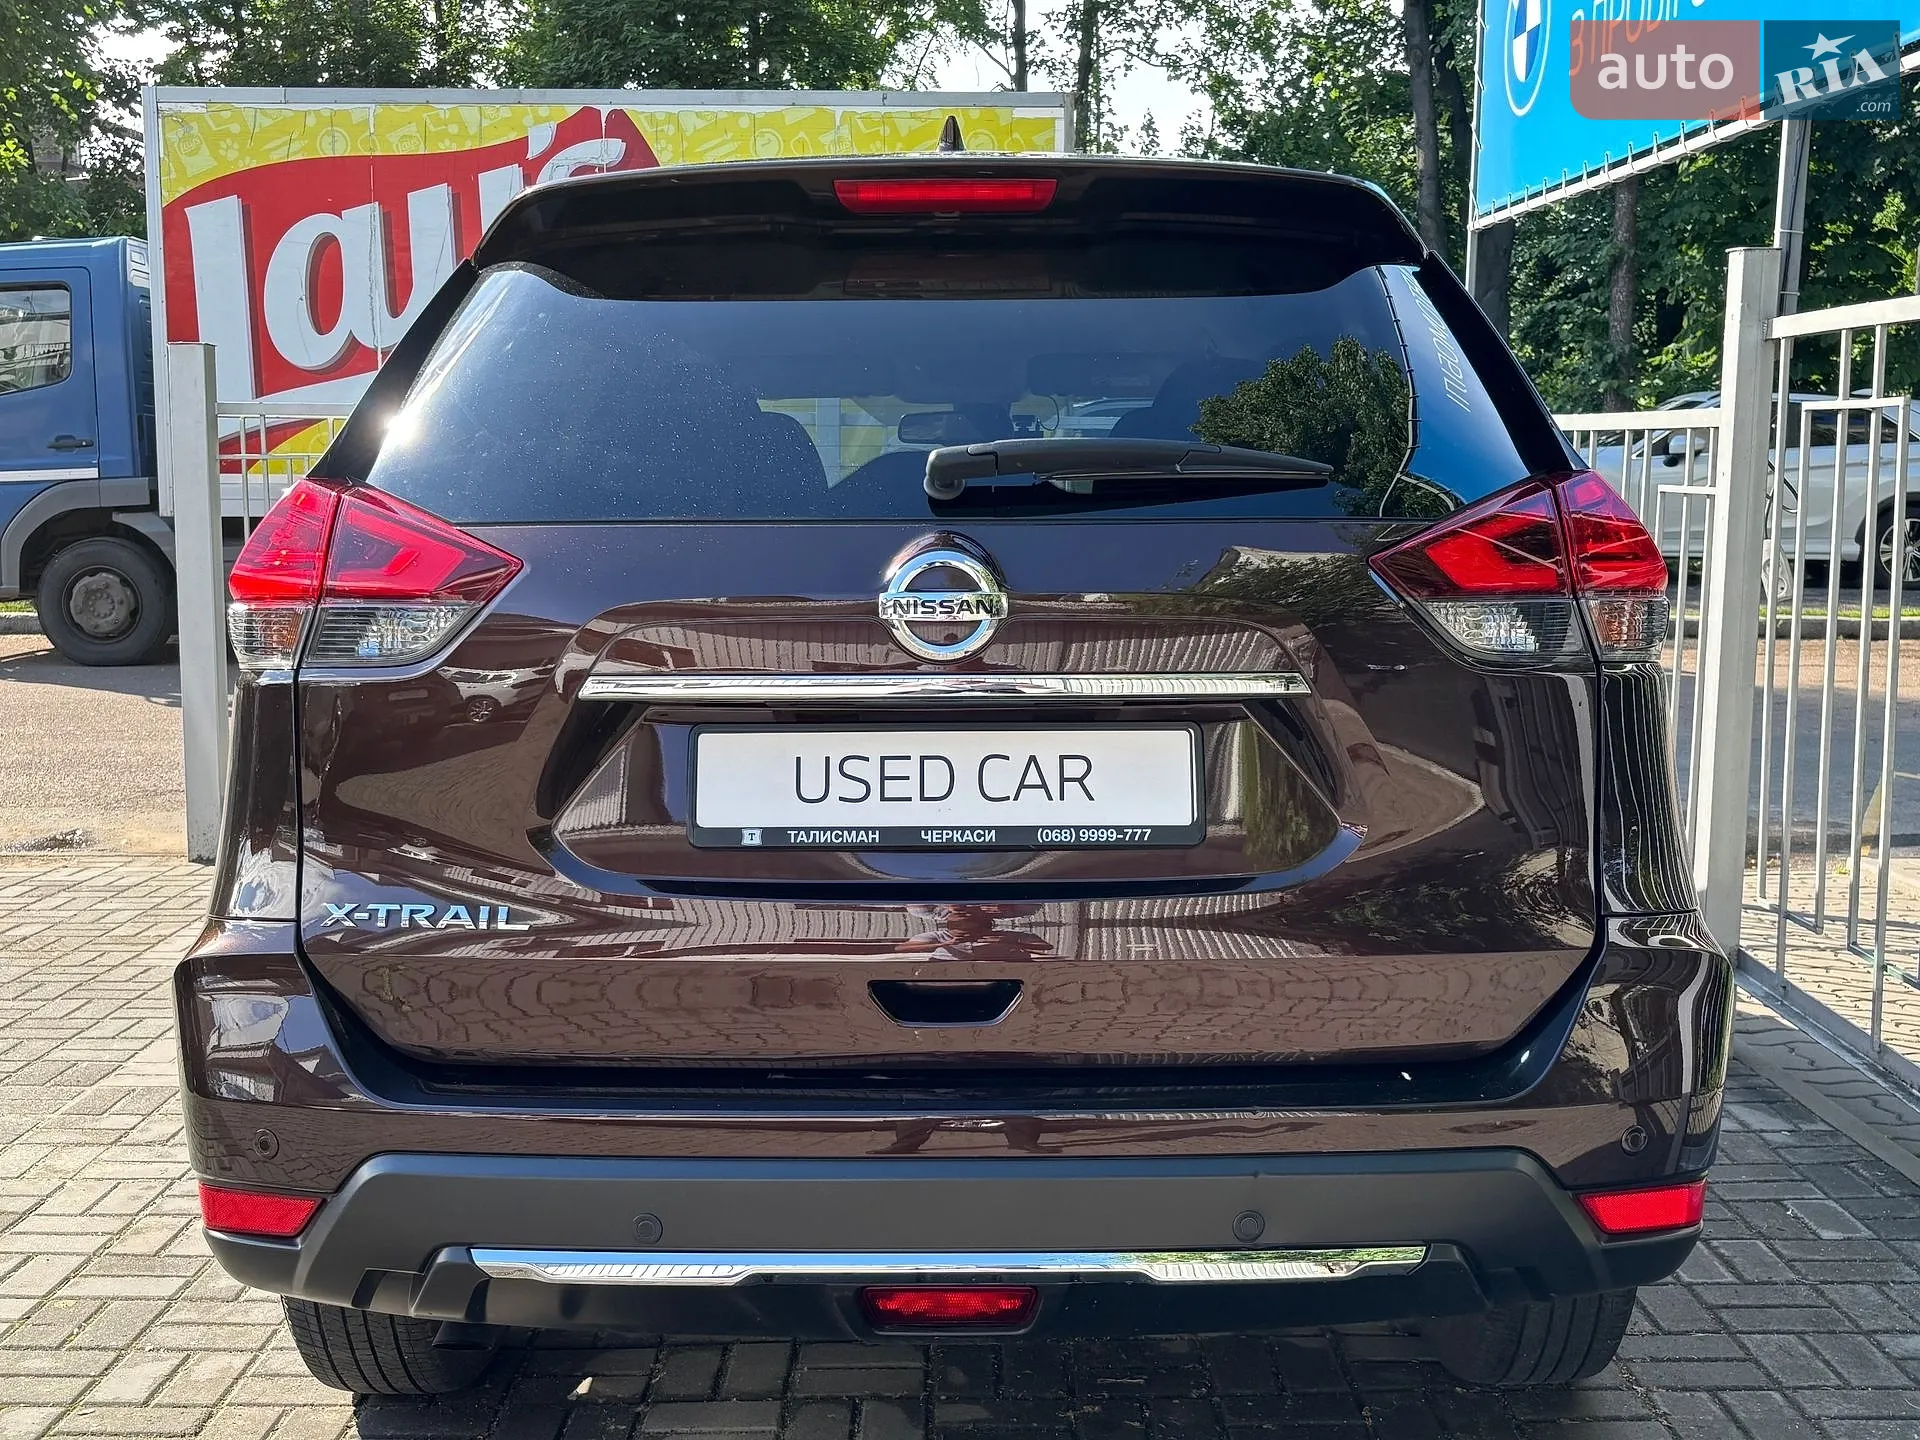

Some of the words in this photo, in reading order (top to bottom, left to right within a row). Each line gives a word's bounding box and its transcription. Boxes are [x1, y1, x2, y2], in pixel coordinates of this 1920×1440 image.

[893, 599, 994, 615] NISSAN
[794, 754, 955, 803] USED
[978, 754, 1096, 803] CAR
[787, 830, 880, 843] ТАЛИСМАН
[921, 829, 996, 843] ЧЕРКАСИ
[1037, 828, 1076, 844] (068)
[1079, 828, 1152, 843] 9999-777
[320, 902, 532, 931] X-TRAIL
